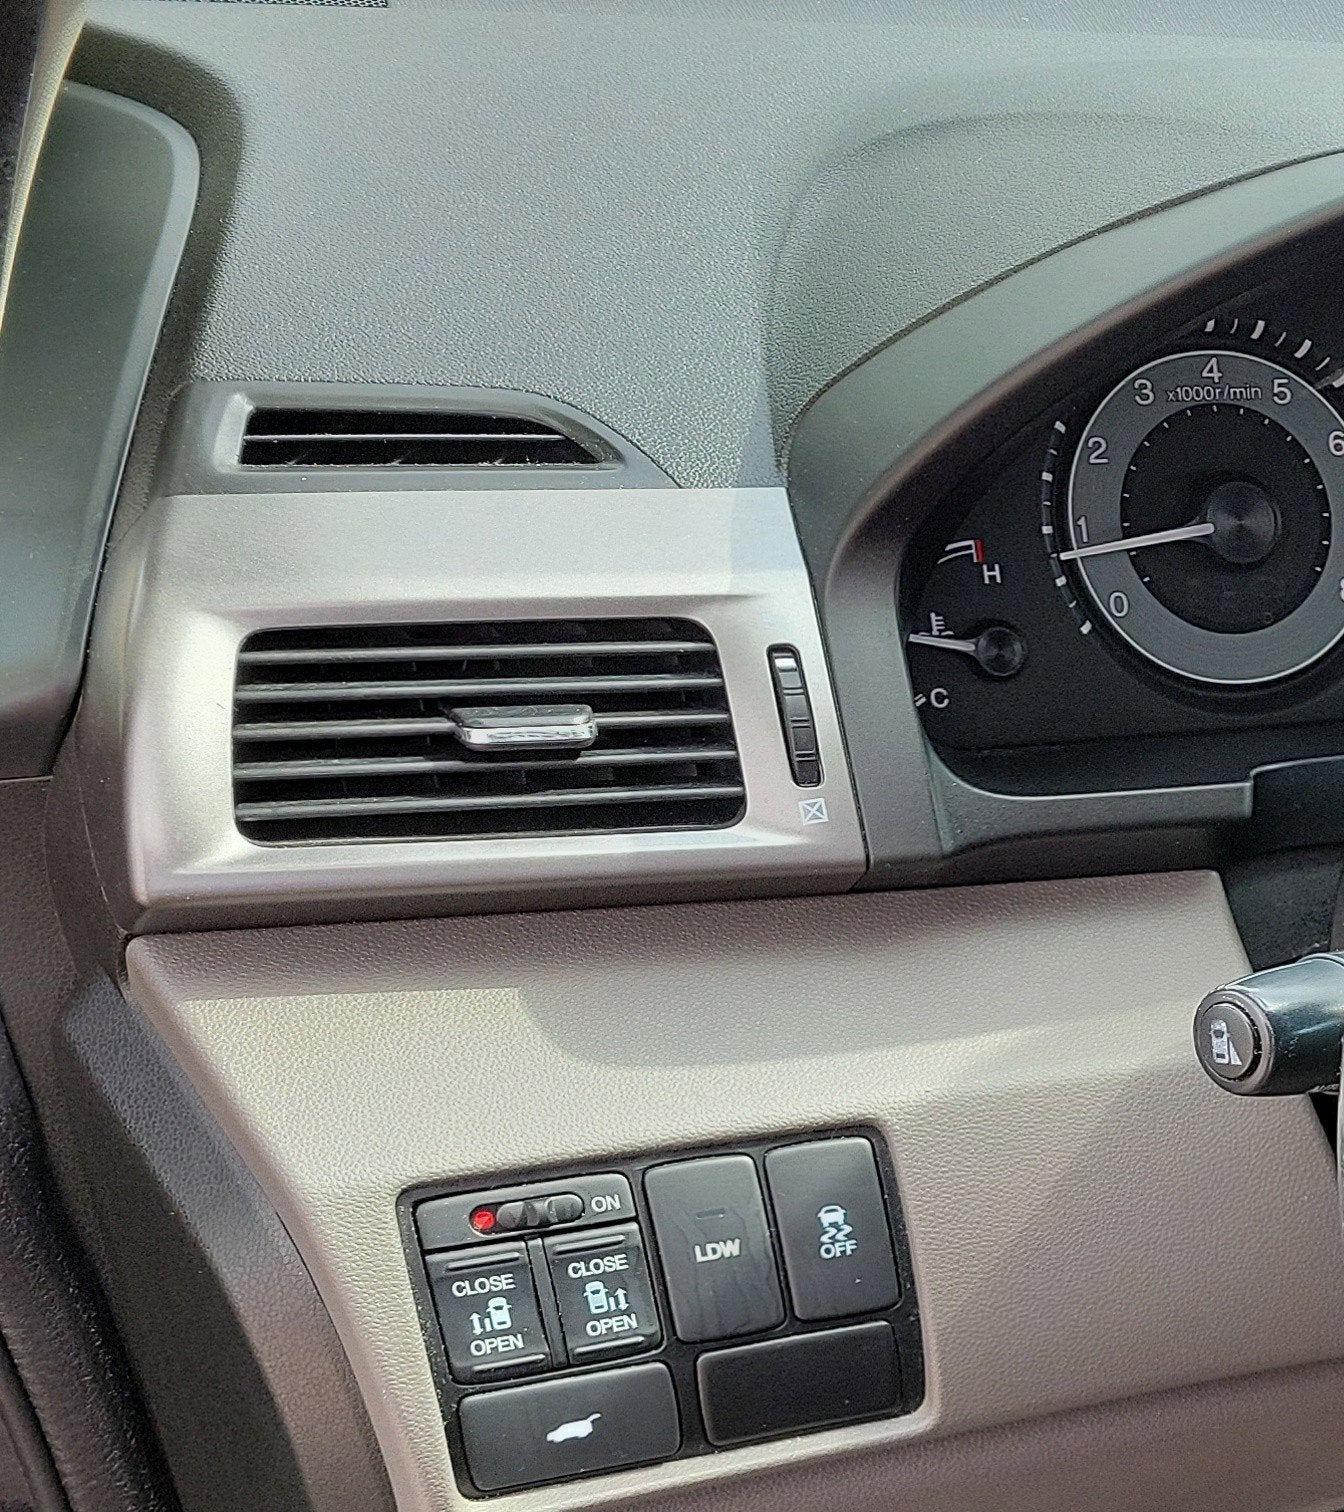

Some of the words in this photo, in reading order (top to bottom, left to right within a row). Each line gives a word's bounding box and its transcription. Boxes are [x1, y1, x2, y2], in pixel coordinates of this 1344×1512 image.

[1201, 358, 1222, 383] 4
[1133, 380, 1154, 405] 3
[1273, 378, 1292, 404] 5
[1088, 437, 1109, 464] 2
[1075, 518, 1090, 542] 1
[983, 564, 1001, 584] H
[1108, 592, 1129, 617] 0
[930, 689, 950, 710] C
[591, 1194, 622, 1212] ON
[694, 1237, 741, 1264] LDW
[819, 1239, 857, 1260] OFF
[567, 1254, 629, 1278] CLOSE
[451, 1273, 516, 1298] CLOSE
[585, 1313, 638, 1337] OPEN
[470, 1333, 524, 1357] OPEN
